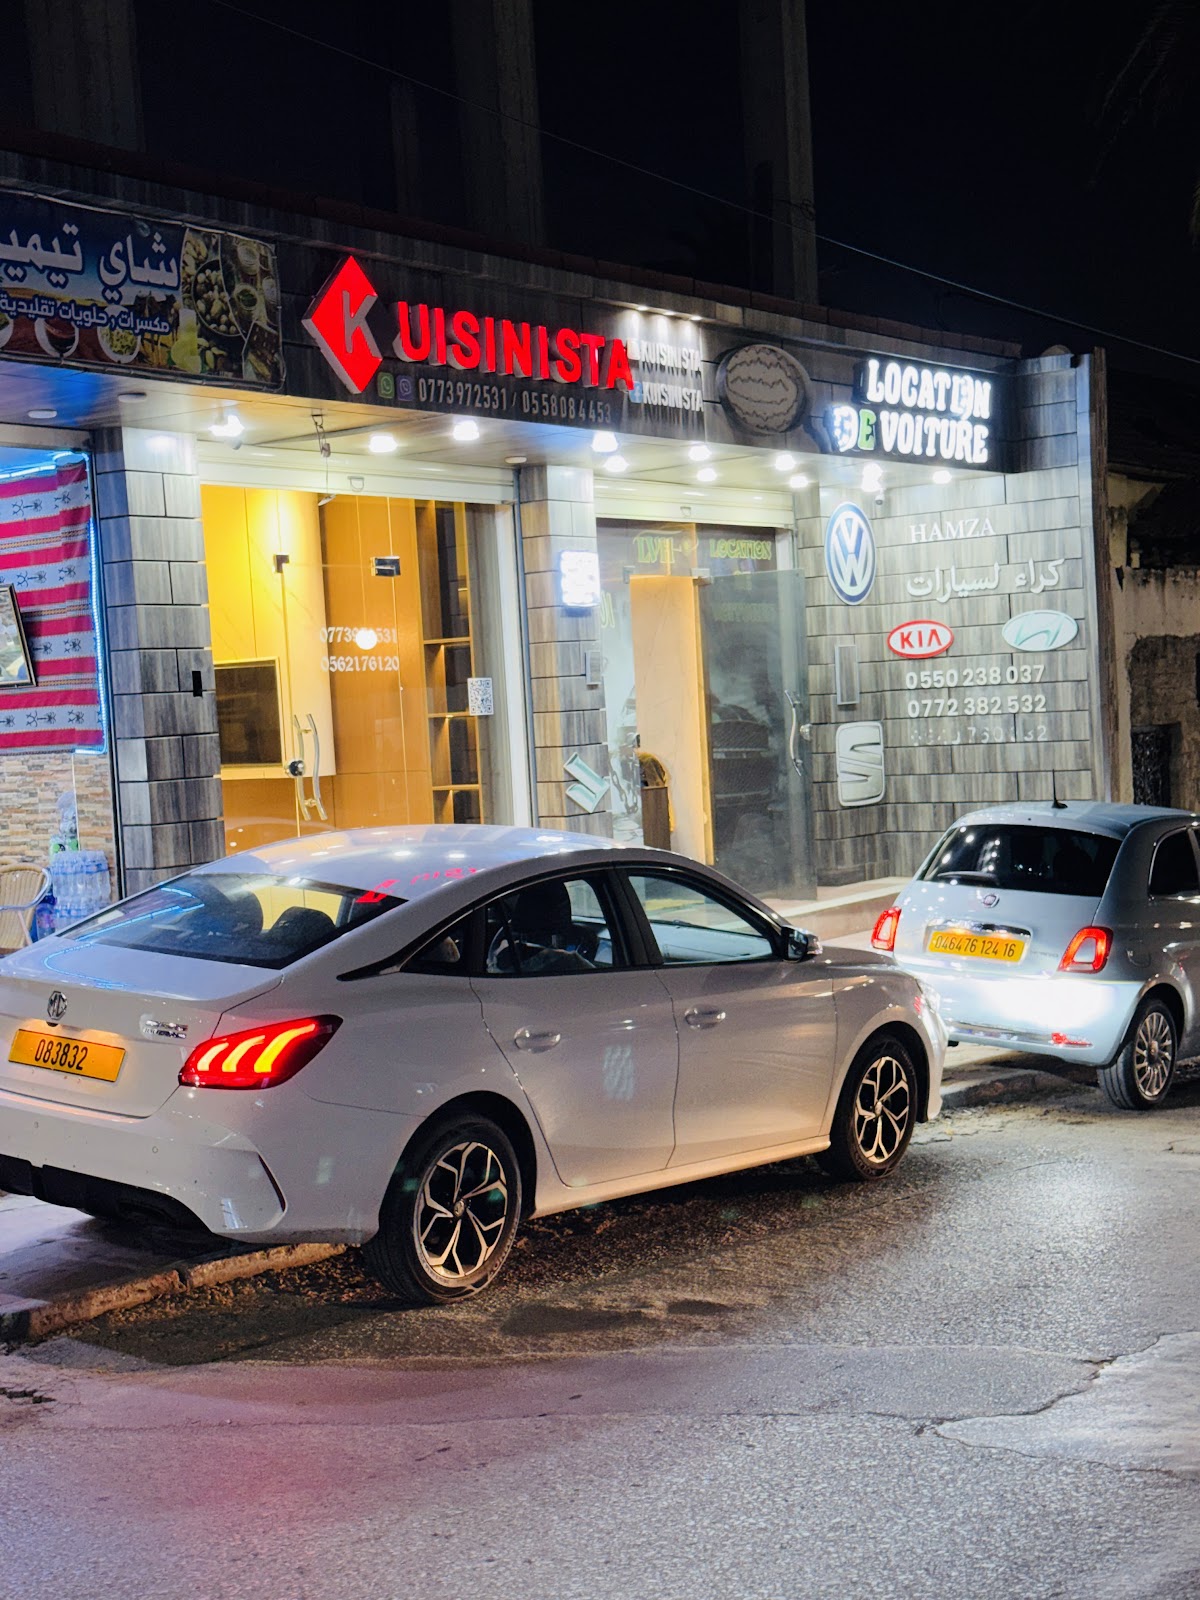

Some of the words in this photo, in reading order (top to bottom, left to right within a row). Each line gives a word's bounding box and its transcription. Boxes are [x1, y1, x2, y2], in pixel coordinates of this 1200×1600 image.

[0, 222, 83, 285] تيمي
[100, 231, 179, 300] شاي
[0, 294, 55, 318] تقليدية
[59, 302, 107, 326] حلويات
[118, 311, 170, 333] مكسرات
[640, 341, 702, 371] KUISINISTA
[418, 378, 507, 411] 0773972531
[522, 390, 611, 423] 0558084453
[643, 381, 704, 412] KUISINISTA
[866, 358, 992, 421] LOCATION
[880, 410, 989, 464] VOITURE
[910, 517, 996, 544] HAMZA
[709, 538, 772, 561] LOCATION
[1015, 557, 1065, 594] كراء
[320, 626, 398, 644] 07739531
[899, 628, 943, 650] KIA
[320, 655, 399, 673] 0562176120
[905, 669, 959, 690] 0550
[962, 666, 1001, 687] 238
[1006, 664, 1046, 685] 037
[907, 698, 959, 718] 0772
[963, 696, 1002, 716] 382
[1007, 694, 1047, 714] 532
[980, 939, 999, 956] 124
[1002, 943, 1017, 958] 16
[34, 1038, 89, 1071] 083832
